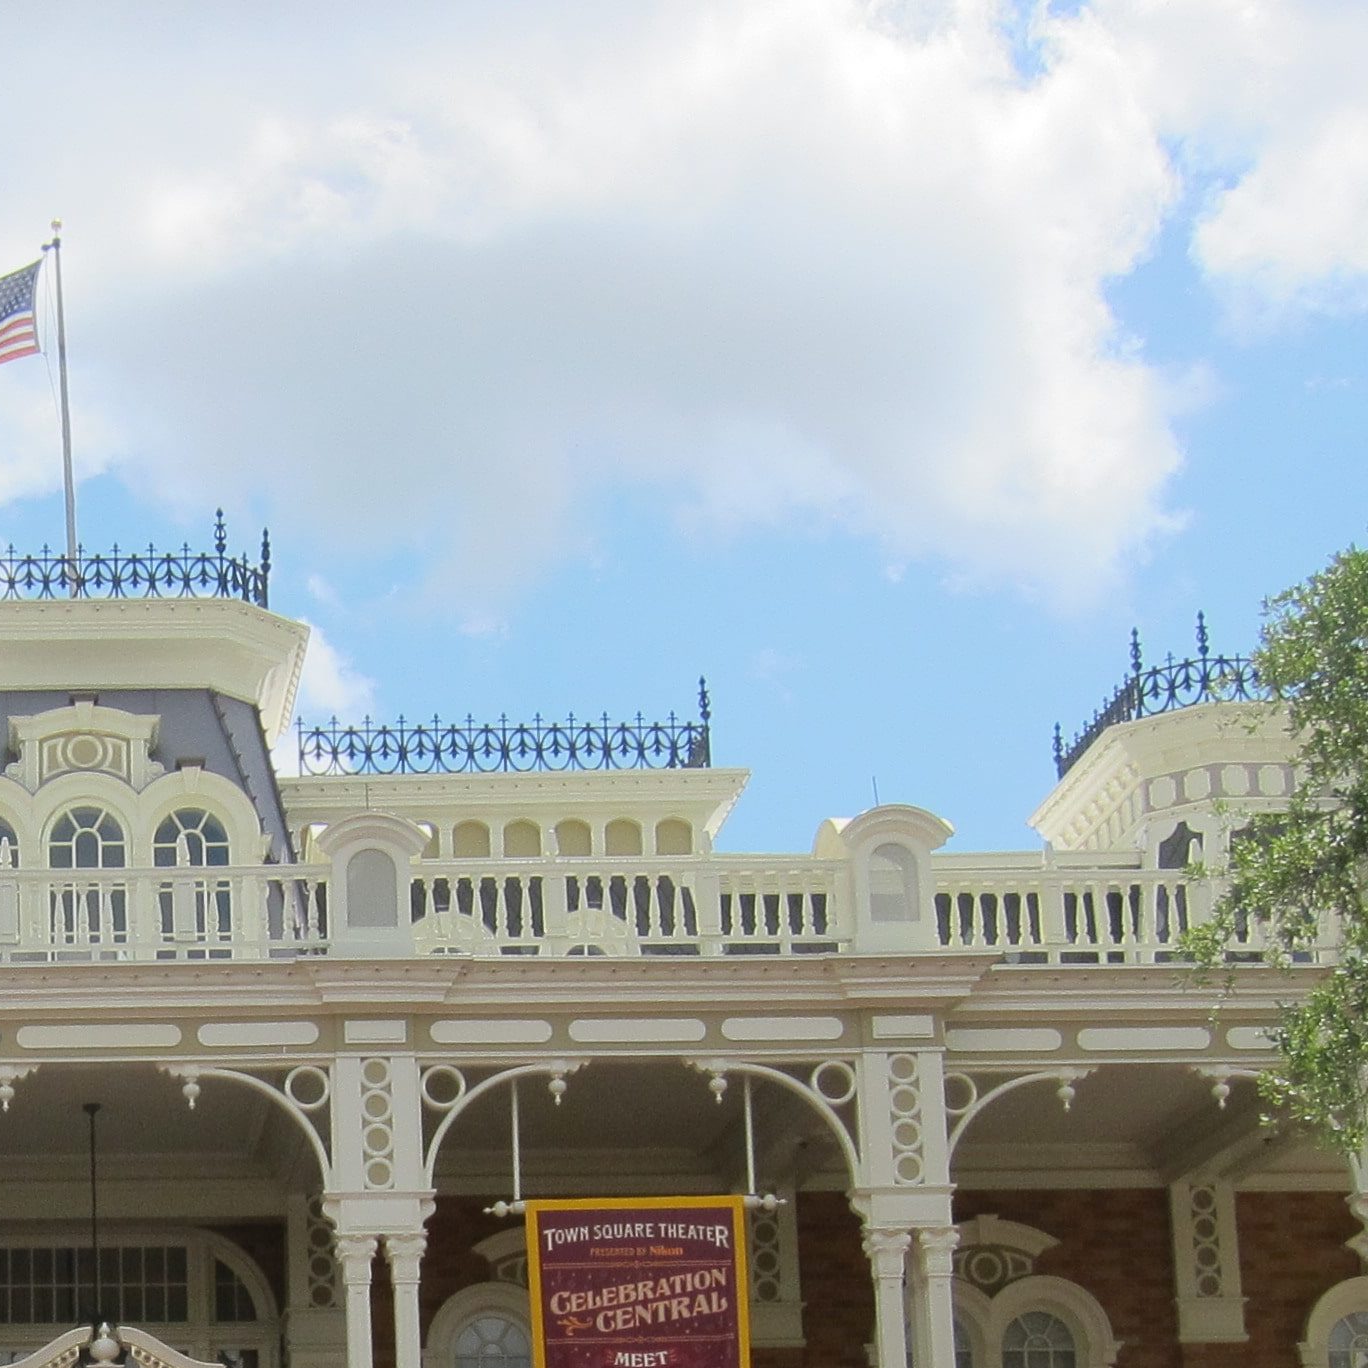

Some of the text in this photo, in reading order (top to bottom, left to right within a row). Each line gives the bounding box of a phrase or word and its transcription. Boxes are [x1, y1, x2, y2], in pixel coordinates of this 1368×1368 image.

[543, 1223, 729, 1251] TOWN SQUARE THEATER
[550, 1267, 727, 1315] CELEBRATION
[596, 1292, 728, 1333] CENTRAL
[614, 1351, 668, 1368] MEET
